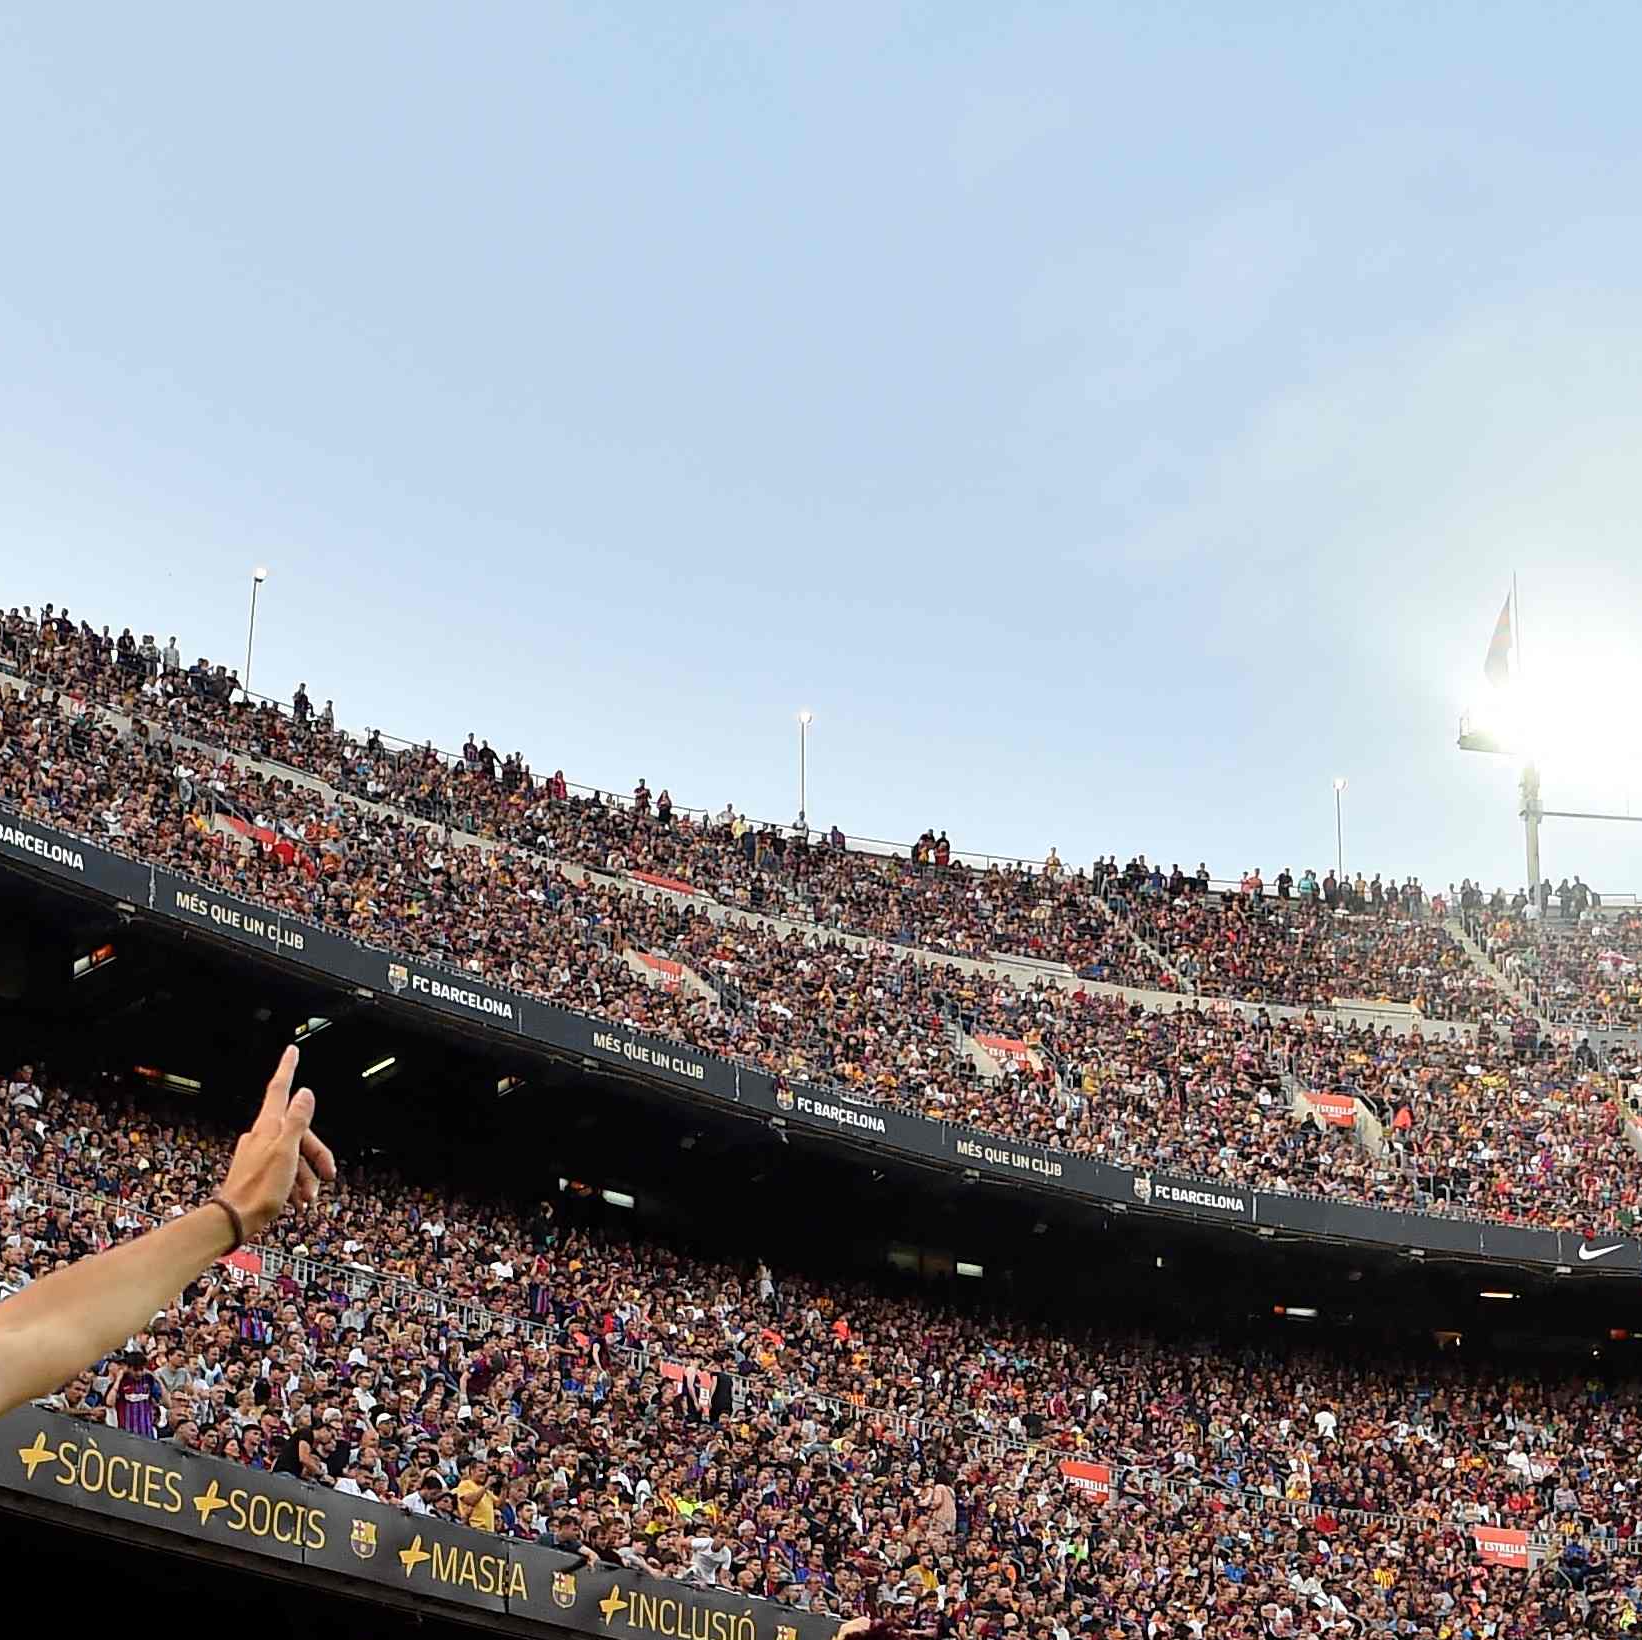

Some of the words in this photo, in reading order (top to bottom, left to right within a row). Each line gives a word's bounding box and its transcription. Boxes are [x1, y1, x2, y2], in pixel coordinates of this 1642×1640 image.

[175, 890, 208, 915] MÉS
[210, 904, 240, 928] QUE
[243, 914, 265, 937] UN
[267, 922, 305, 950] CLUB
[412, 975, 431, 993] FC
[431, 980, 513, 1020] BARCELONA
[592, 1031, 621, 1051] MÉS
[623, 1043, 651, 1064] QUE
[652, 1050, 670, 1069] UN
[671, 1058, 704, 1080] CLUB
[796, 1096, 813, 1113] FC
[814, 1102, 886, 1133] BARCELONA
[956, 1140, 983, 1159] MÉS
[984, 1148, 1010, 1166] QUE
[1012, 1154, 1030, 1171] UN
[1031, 1160, 1062, 1177] CLUB
[1155, 1184, 1171, 1199] FC
[1171, 1188, 1245, 1213] BARCELONA
[1484, 1540, 1526, 1553] ESTRELLA
